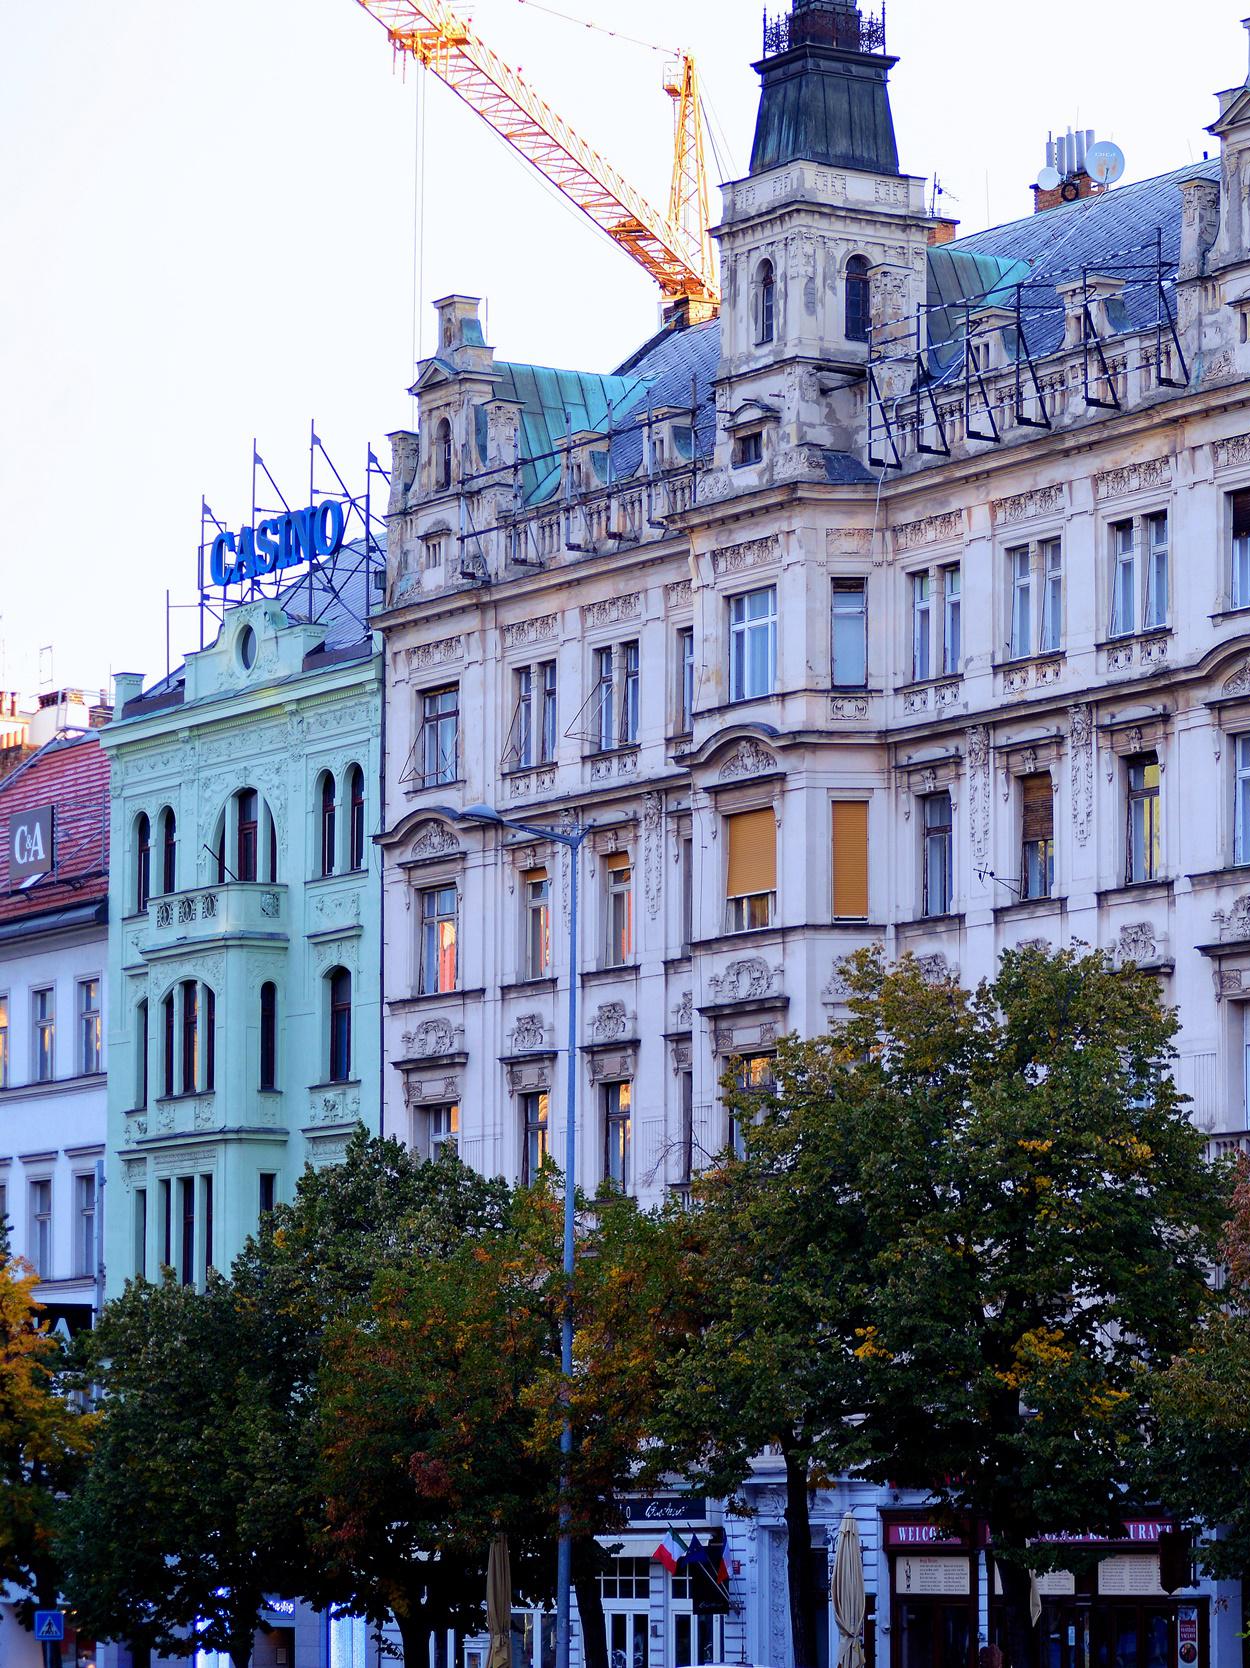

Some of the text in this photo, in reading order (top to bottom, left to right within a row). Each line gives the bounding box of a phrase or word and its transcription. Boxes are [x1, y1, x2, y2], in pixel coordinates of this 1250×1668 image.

[210, 499, 344, 587] CASINO
[14, 822, 46, 865] C&A
[898, 1526, 948, 1541] WELCO
